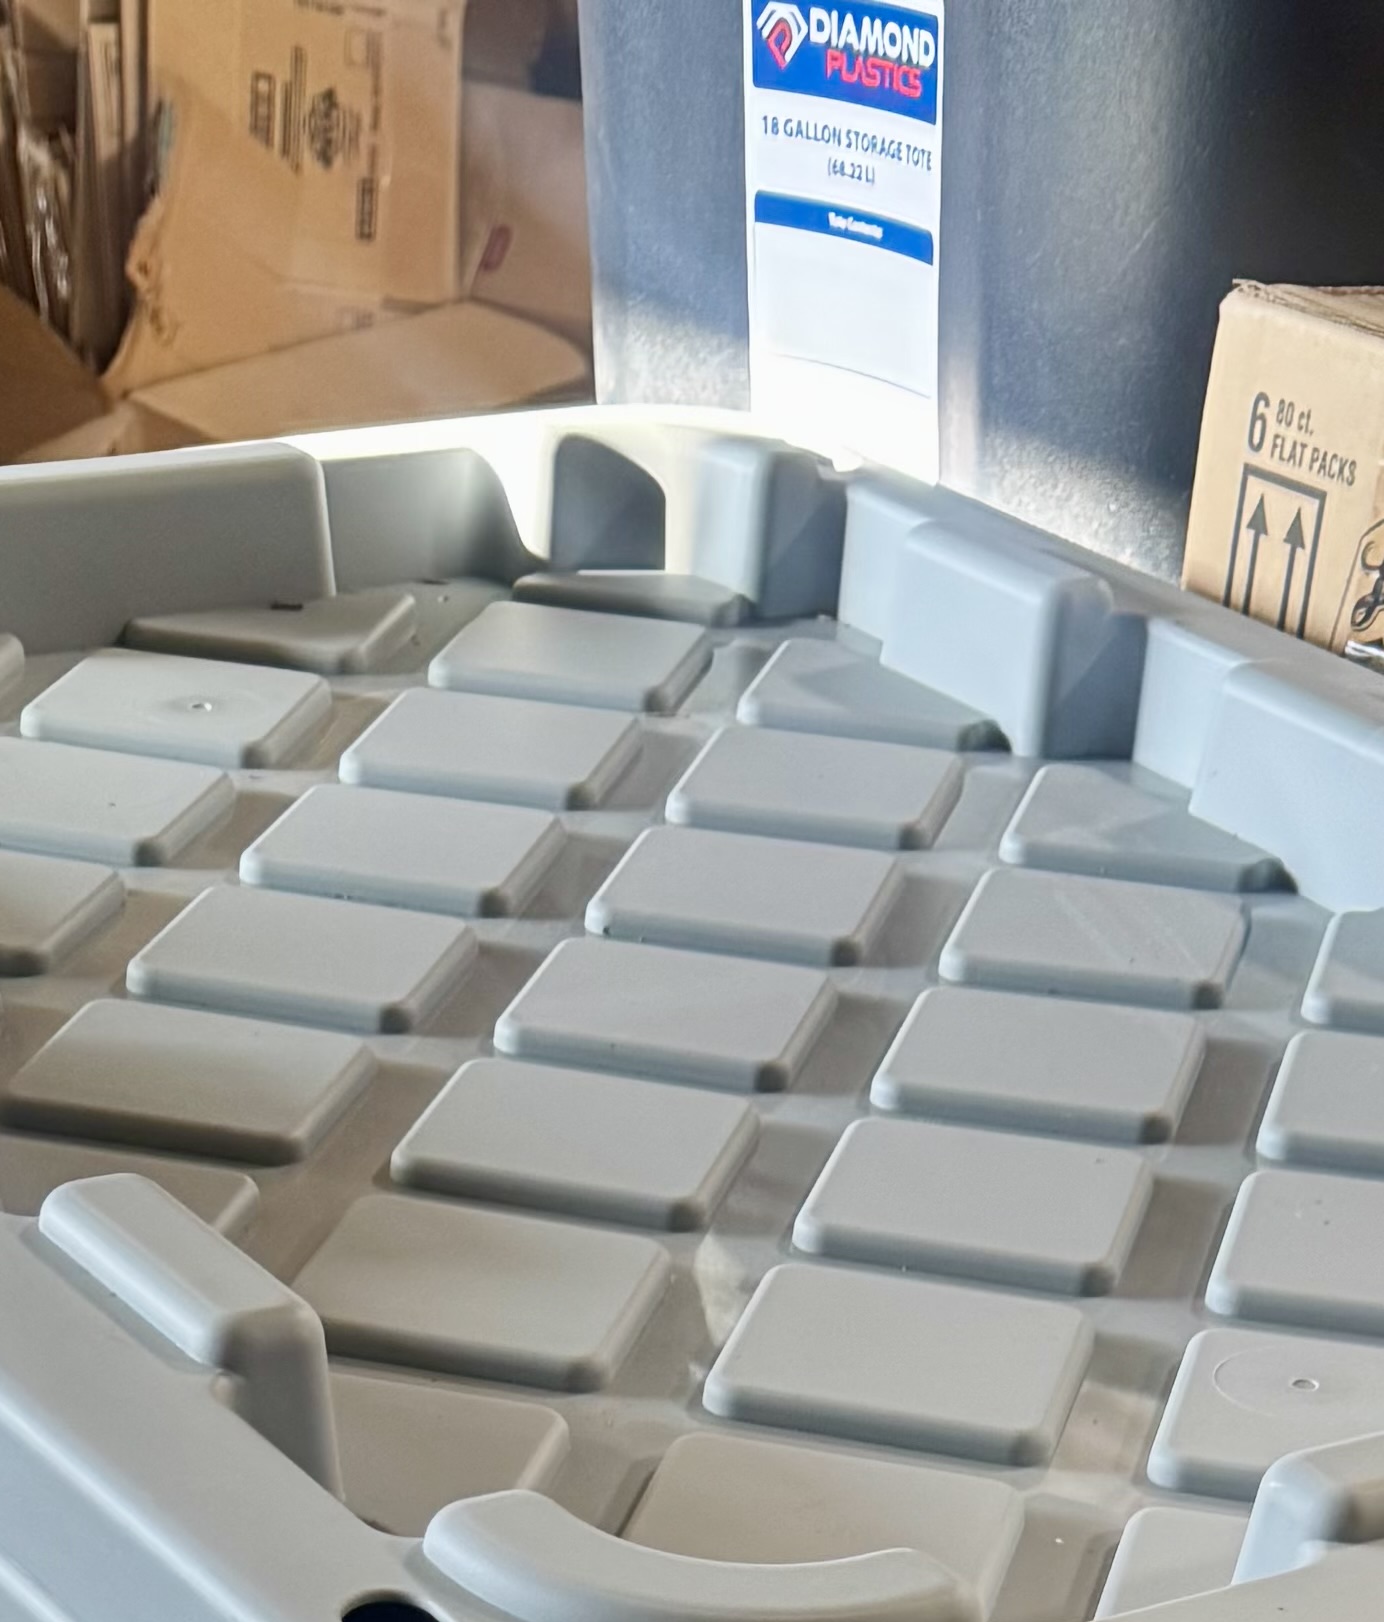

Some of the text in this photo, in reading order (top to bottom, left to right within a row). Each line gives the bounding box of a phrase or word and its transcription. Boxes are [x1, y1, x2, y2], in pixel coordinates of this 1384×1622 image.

[809, 7, 936, 68] DIAMOND
[826, 49, 923, 99] PLASTICS
[762, 115, 932, 171] 18 GALLON STORAGE TOTE
[1247, 391, 1271, 453] 6
[1276, 398, 1296, 428] 80
[1270, 433, 1358, 487] FLAT PACKS
